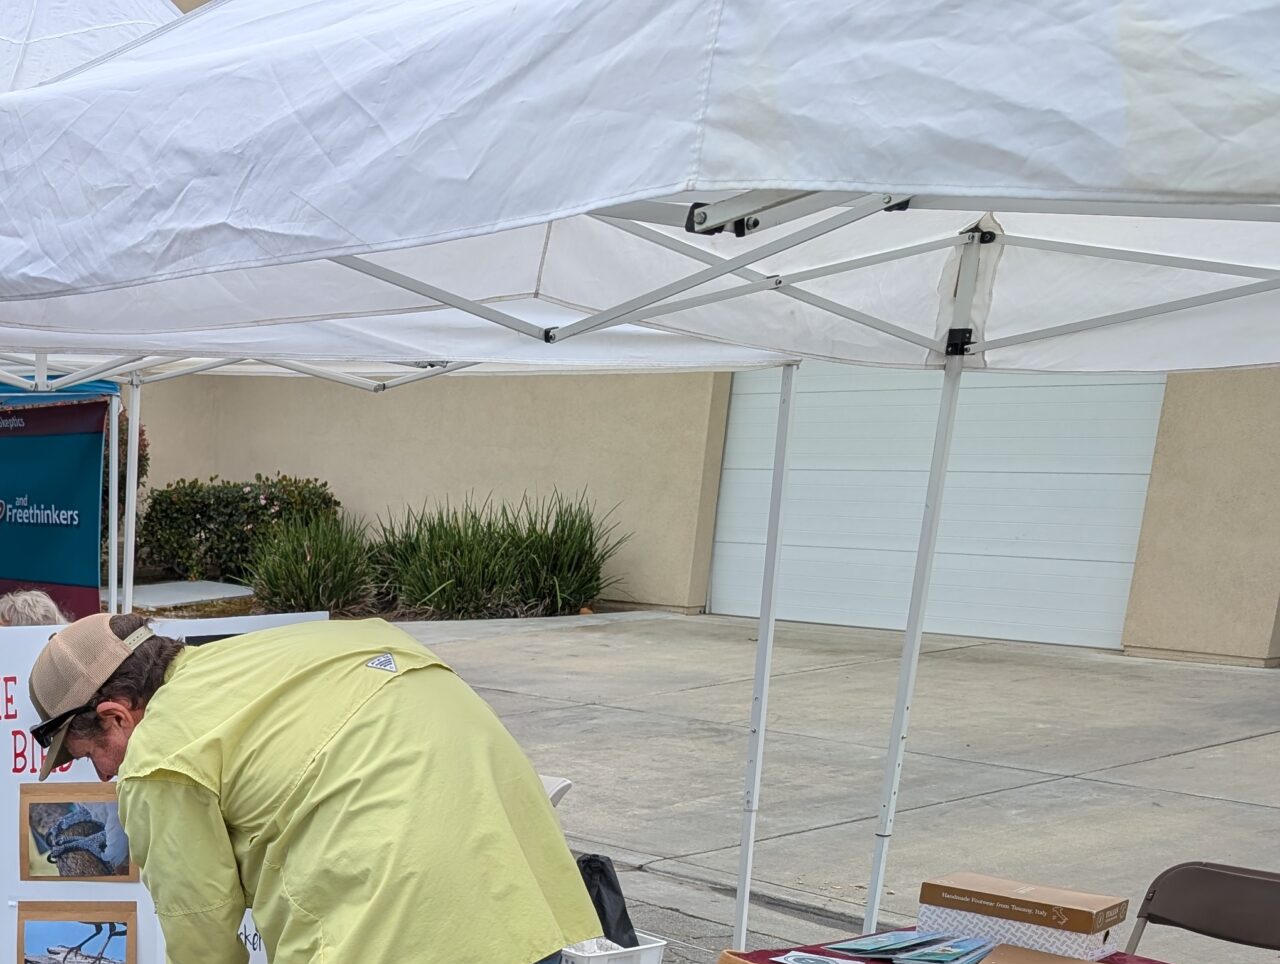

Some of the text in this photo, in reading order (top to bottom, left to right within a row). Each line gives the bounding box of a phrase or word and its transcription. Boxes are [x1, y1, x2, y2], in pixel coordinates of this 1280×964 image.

[15, 494, 28, 506] and
[6, 504, 79, 525] Freethinkers
[942, 892, 971, 902] Handmade
[1035, 908, 1048, 917] Italy
